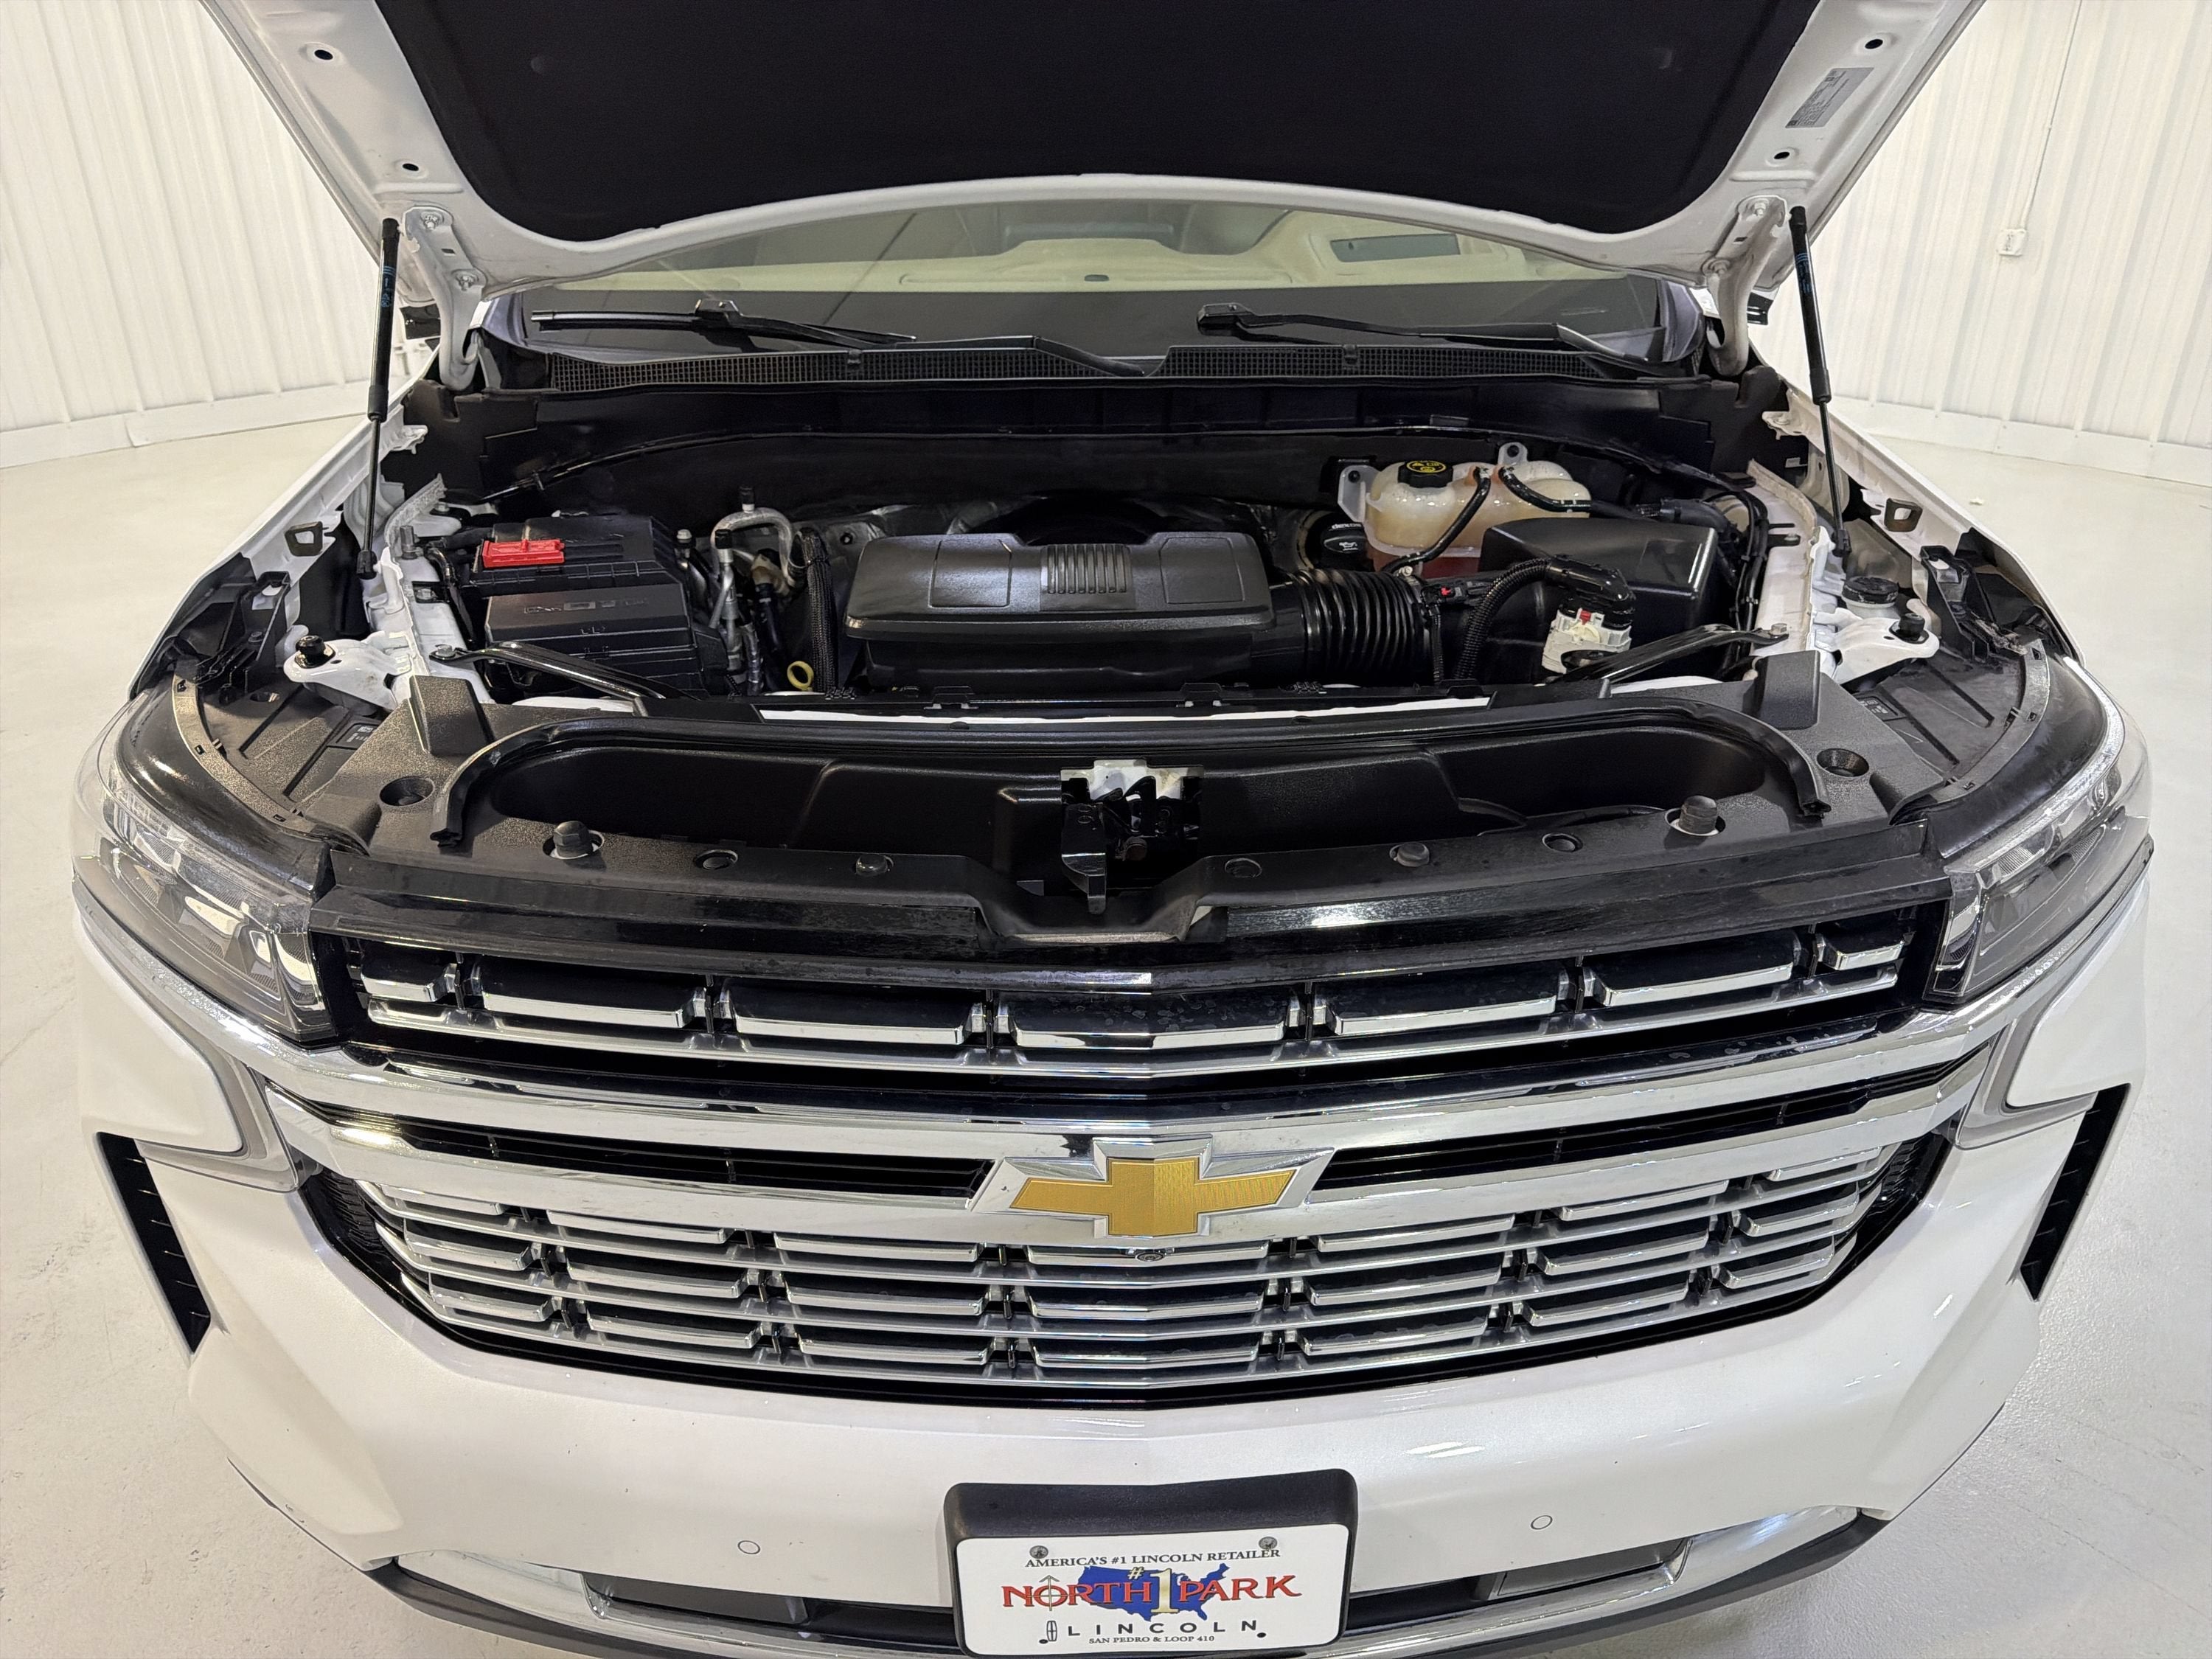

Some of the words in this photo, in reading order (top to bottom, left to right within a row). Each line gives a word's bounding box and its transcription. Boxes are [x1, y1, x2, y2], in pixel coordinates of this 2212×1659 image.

[1025, 1557, 1107, 1568] AMERICA'S
[1111, 1556, 1127, 1565] #1
[1132, 1553, 1203, 1564] LINCOLN
[1207, 1549, 1281, 1562] RETAILER
[1001, 1582, 1152, 1607] NORTH
[1179, 1575, 1302, 1602] PARK
[1068, 1620, 1256, 1636] LINCOLN
